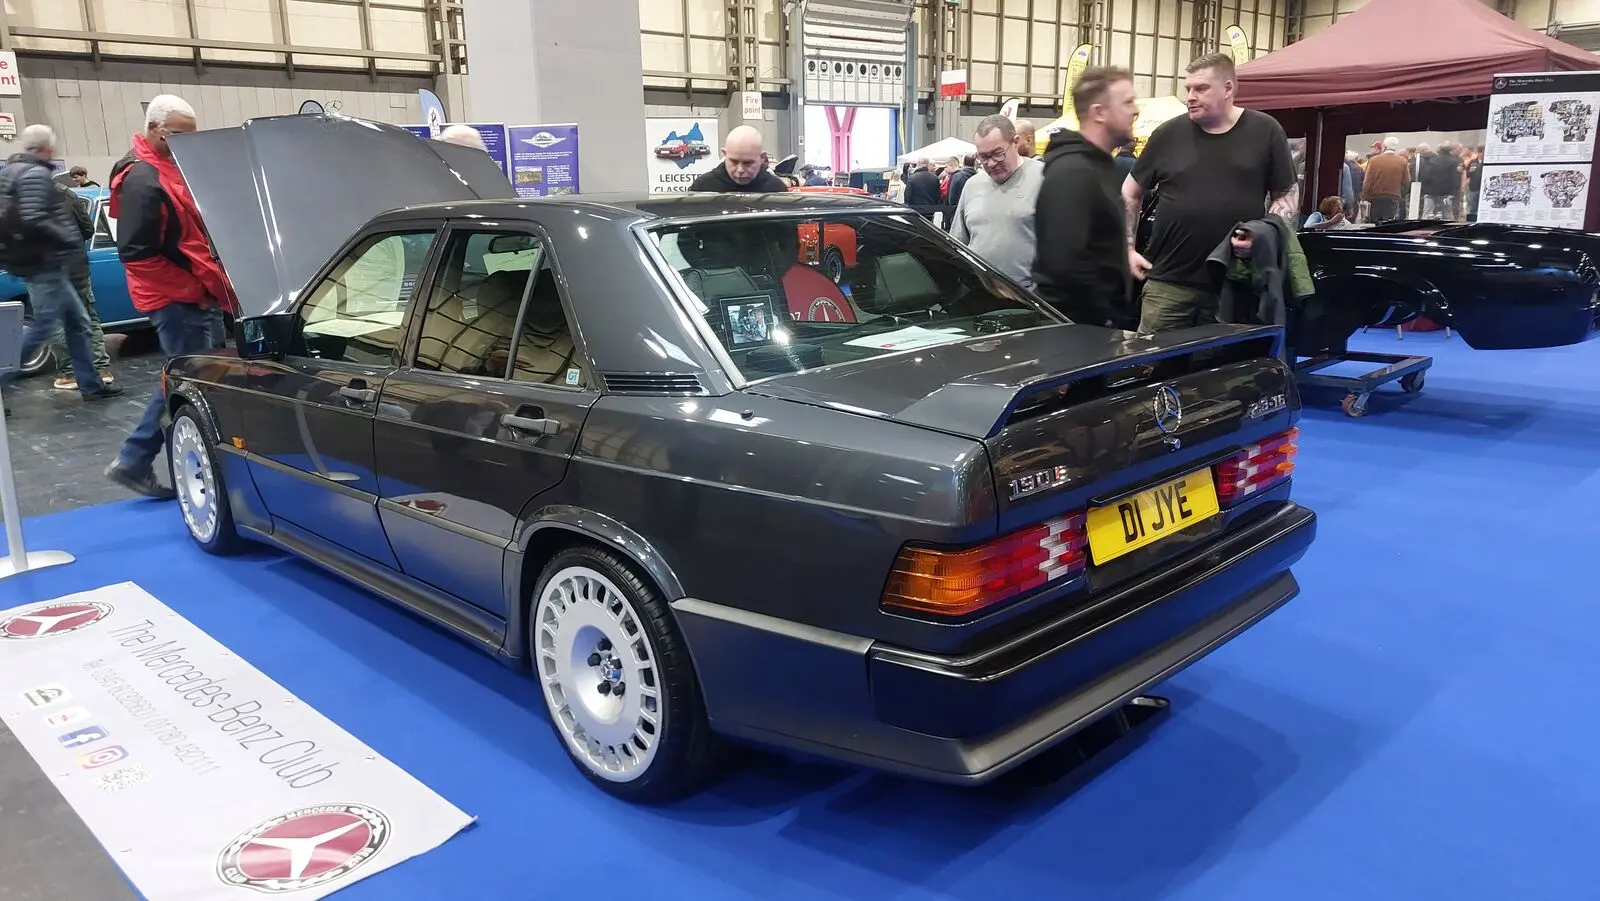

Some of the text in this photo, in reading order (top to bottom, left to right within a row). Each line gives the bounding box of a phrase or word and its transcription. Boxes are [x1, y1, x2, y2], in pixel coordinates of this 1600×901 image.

[745, 95, 759, 105] Fire
[744, 106, 761, 115] point
[659, 173, 701, 183] LEICEST
[1009, 470, 1051, 497] 190
[1151, 480, 1193, 531] JYE
[107, 619, 340, 789] The Mercedes-Benz Club
